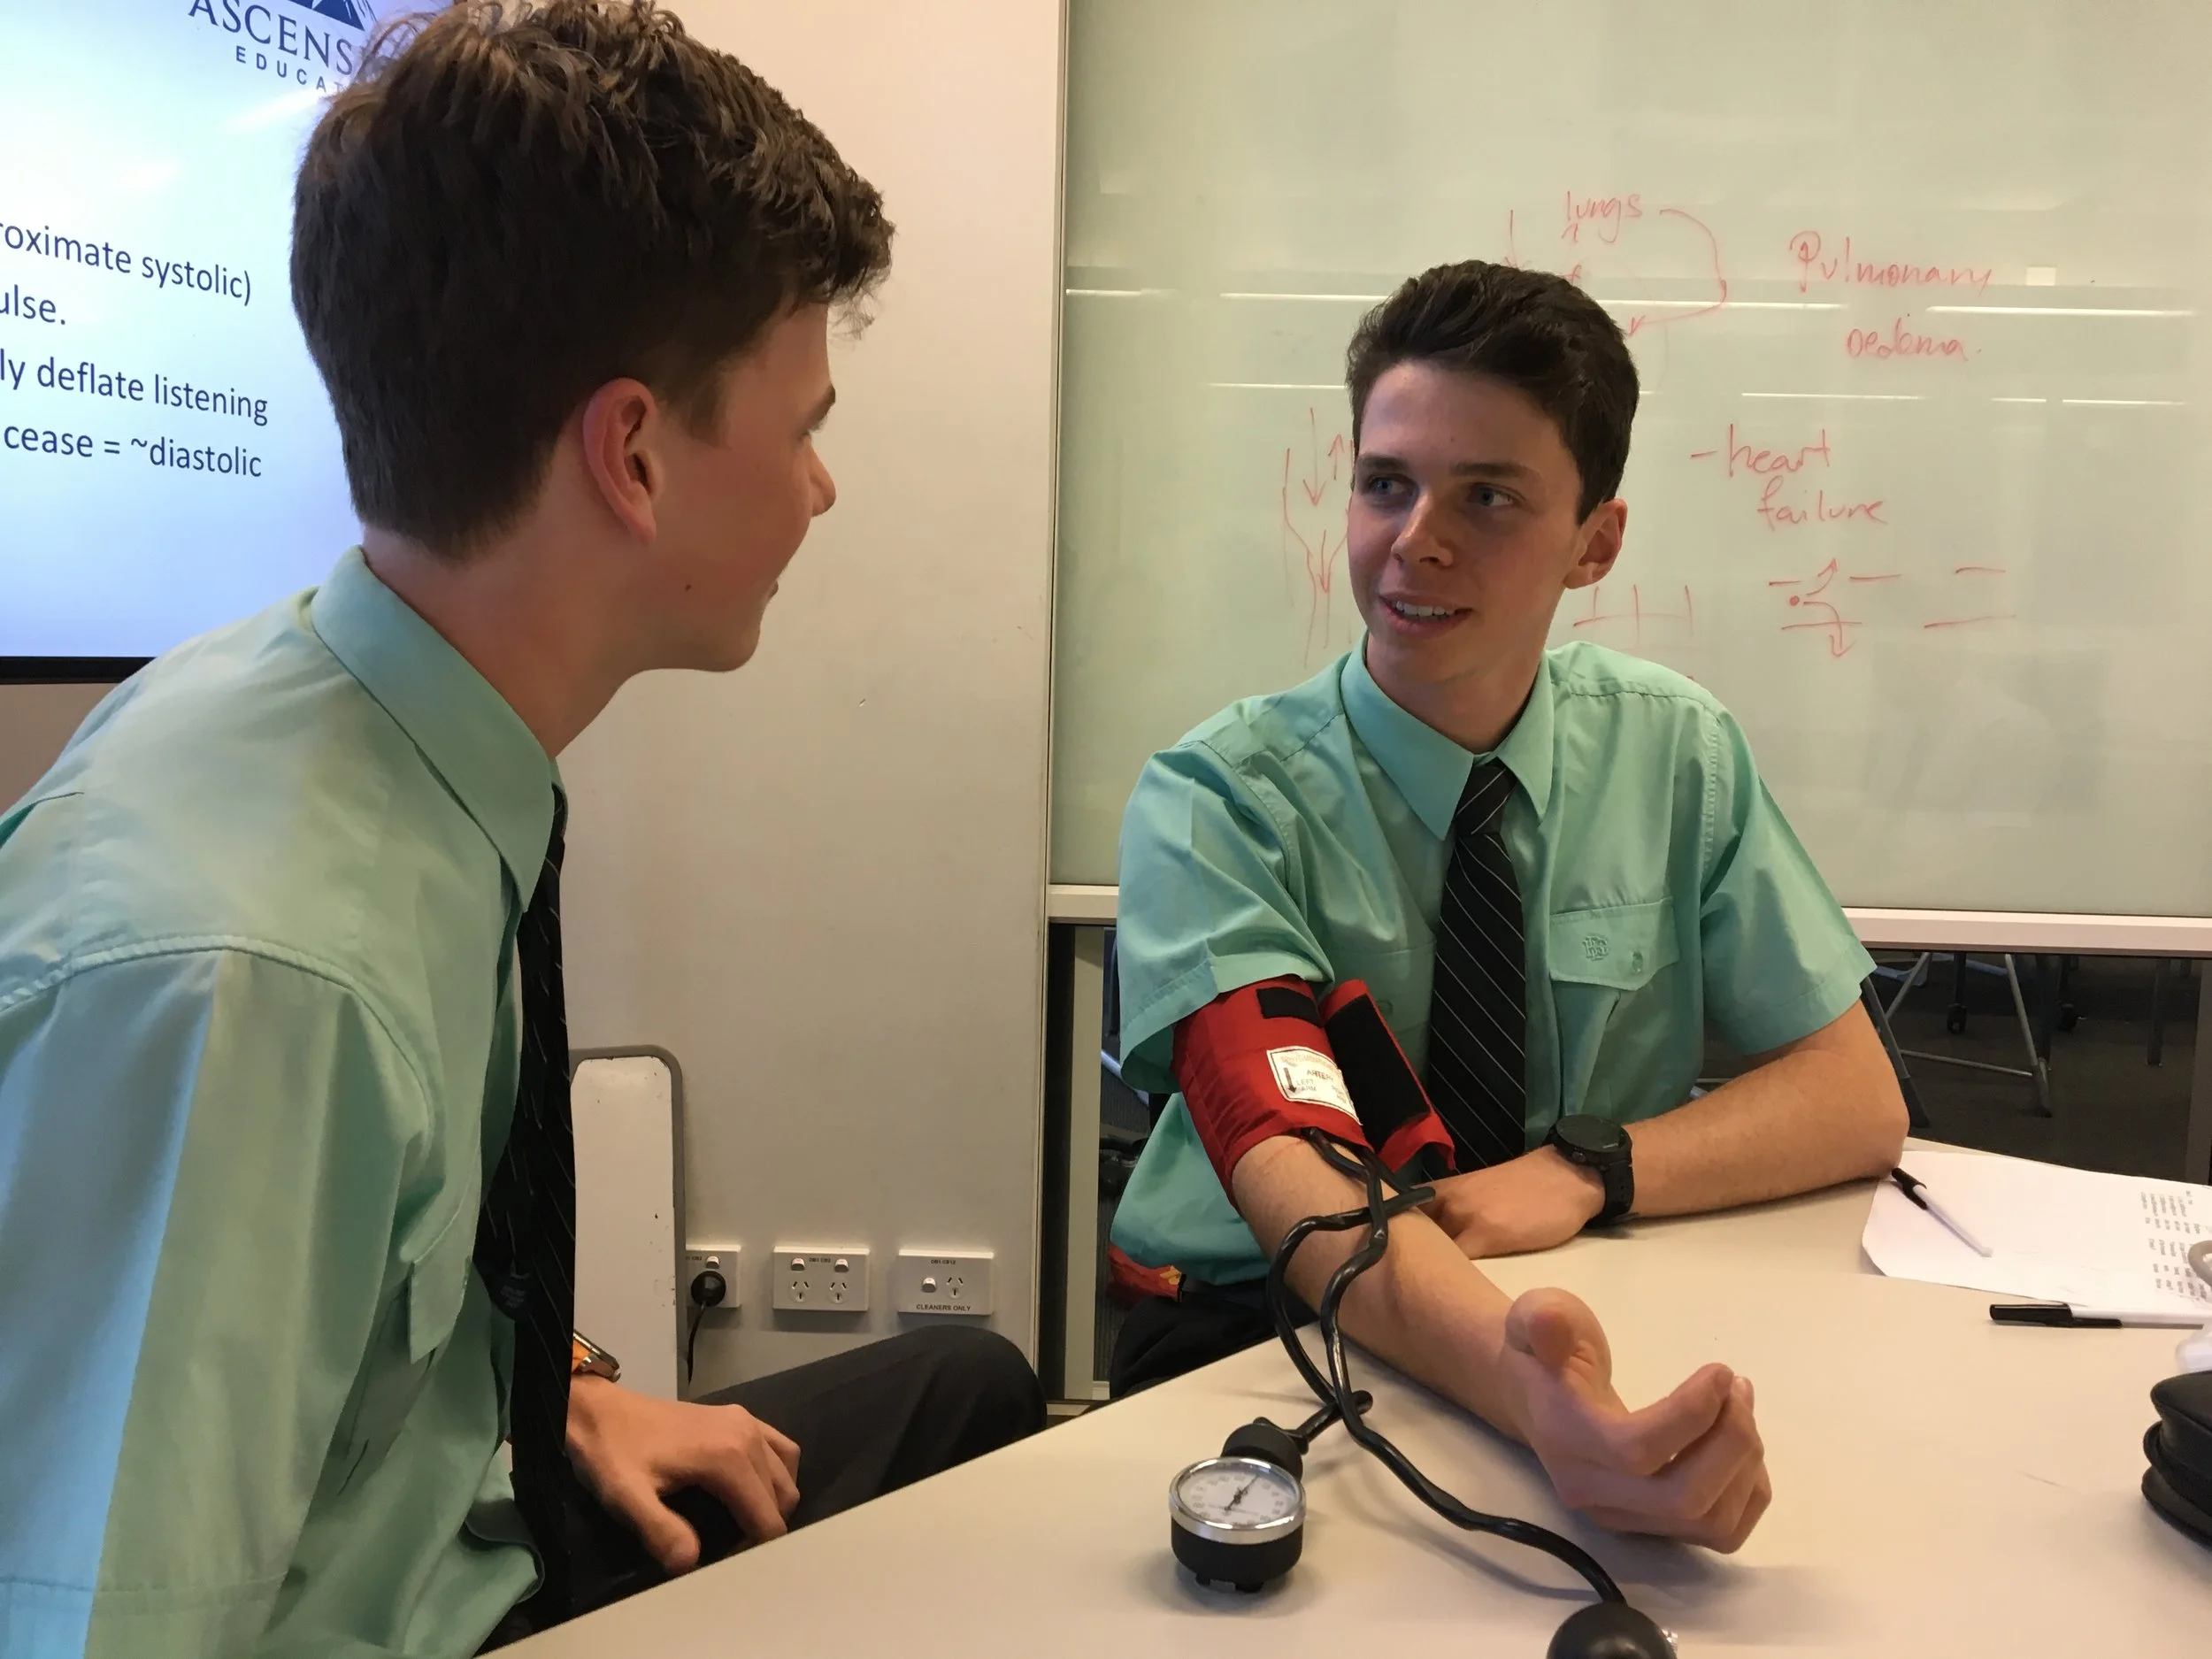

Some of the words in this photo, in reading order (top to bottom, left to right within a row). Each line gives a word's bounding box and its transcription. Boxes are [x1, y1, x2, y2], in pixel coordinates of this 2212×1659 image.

[1565, 190, 1643, 243] lungs
[0, 223, 132, 273] oximate
[142, 256, 251, 307] systolic)
[1789, 230, 1993, 296] Pulmonary
[37, 357, 144, 401] deflate
[155, 373, 268, 426] listening
[4, 426, 94, 457] cease
[1757, 475, 1888, 532] failure
